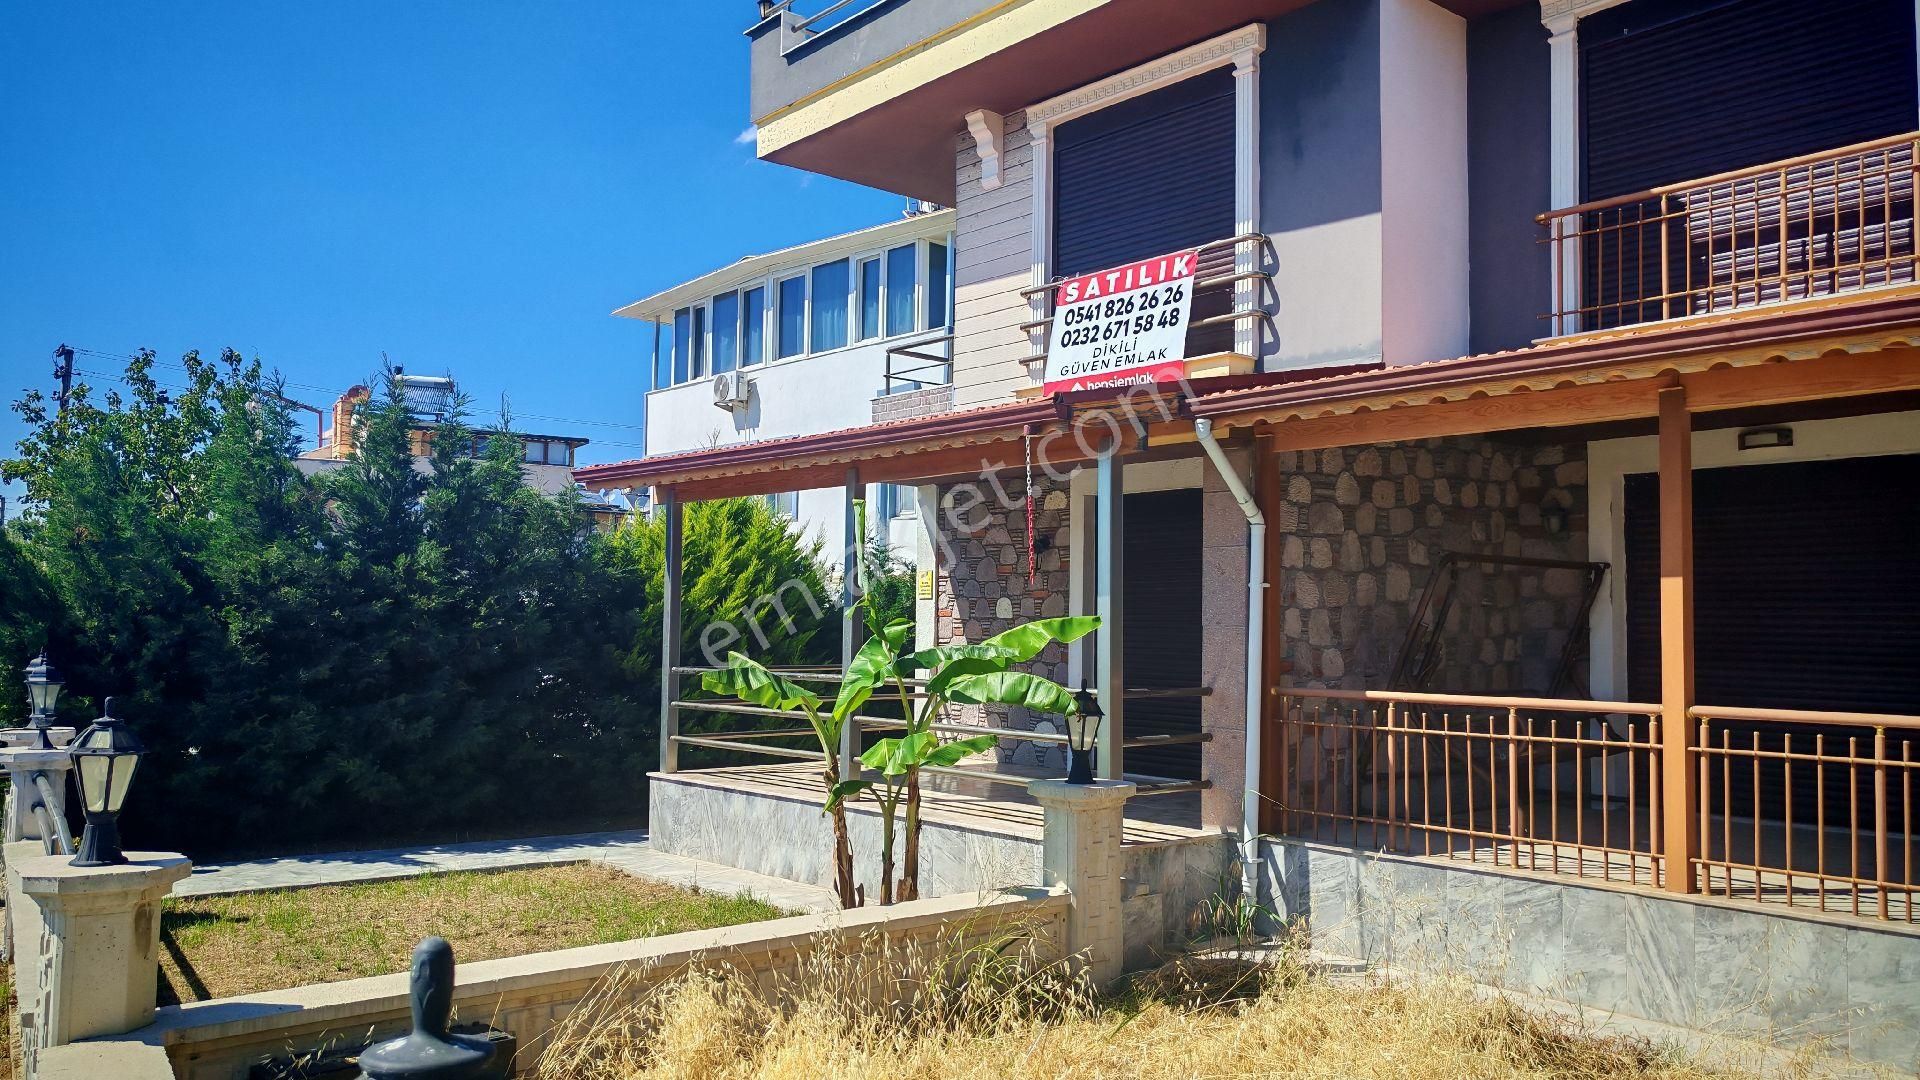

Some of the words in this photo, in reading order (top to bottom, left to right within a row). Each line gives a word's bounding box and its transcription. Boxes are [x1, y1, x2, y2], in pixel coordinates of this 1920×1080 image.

[1065, 254, 1191, 303] SATILIK
[1064, 303, 1102, 327] 0541
[1104, 295, 1134, 319] 826
[1138, 290, 1159, 312] 26
[1163, 284, 1184, 306] 26
[1061, 325, 1100, 348] 0232
[1103, 319, 1130, 341] 671
[1133, 314, 1154, 335] 58
[1157, 307, 1180, 329] 48
[1092, 336, 1138, 359] DİKİLİ
[1060, 359, 1110, 377] GÜVEN
[1115, 348, 1168, 368] EMLAK
